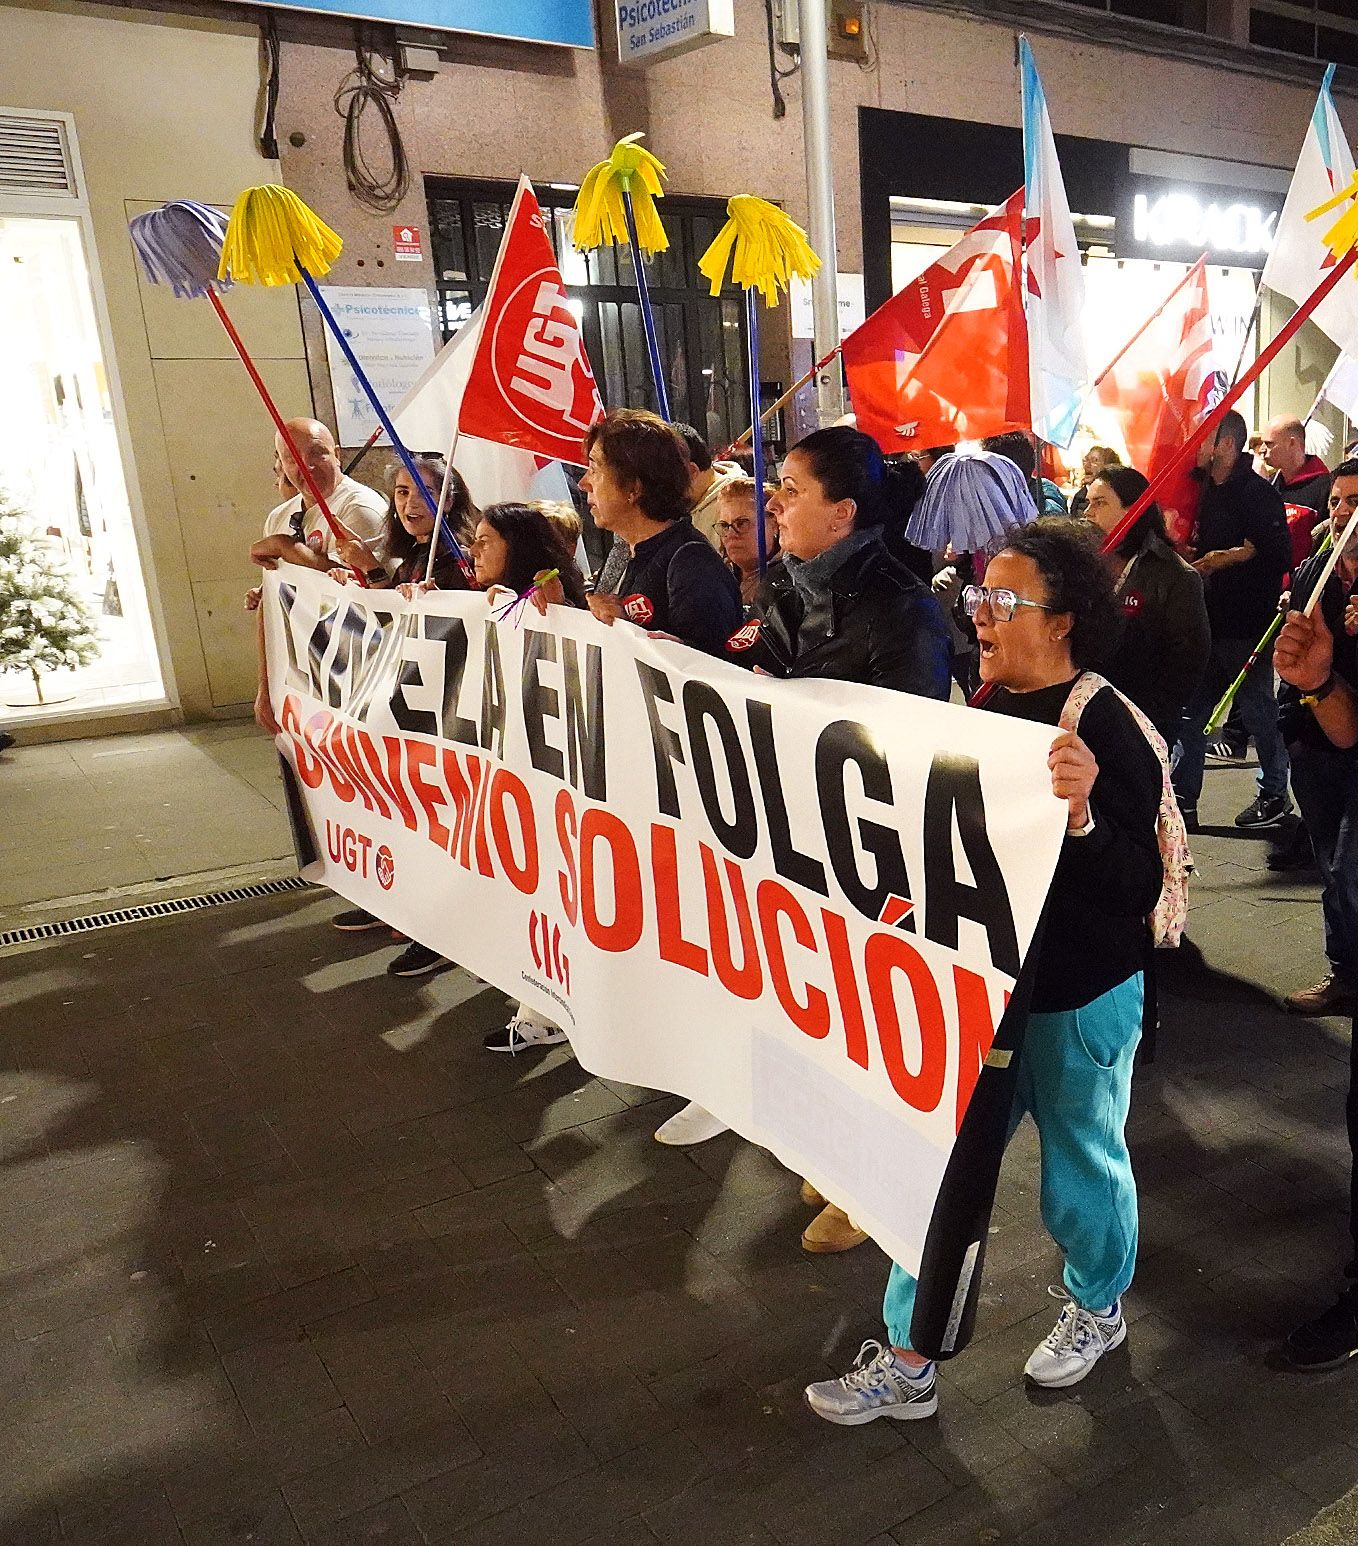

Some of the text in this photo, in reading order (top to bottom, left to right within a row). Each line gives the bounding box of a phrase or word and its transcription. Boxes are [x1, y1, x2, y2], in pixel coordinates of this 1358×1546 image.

[629, 12, 695, 50] San Sebastián
[509, 281, 574, 411] UGT
[278, 582, 1020, 979] LIMPEZA EN FOLGA
[326, 818, 373, 879] UGT
[281, 693, 1016, 1137] CONVENIO SOLUCIÓN
[528, 909, 571, 997] CIG
